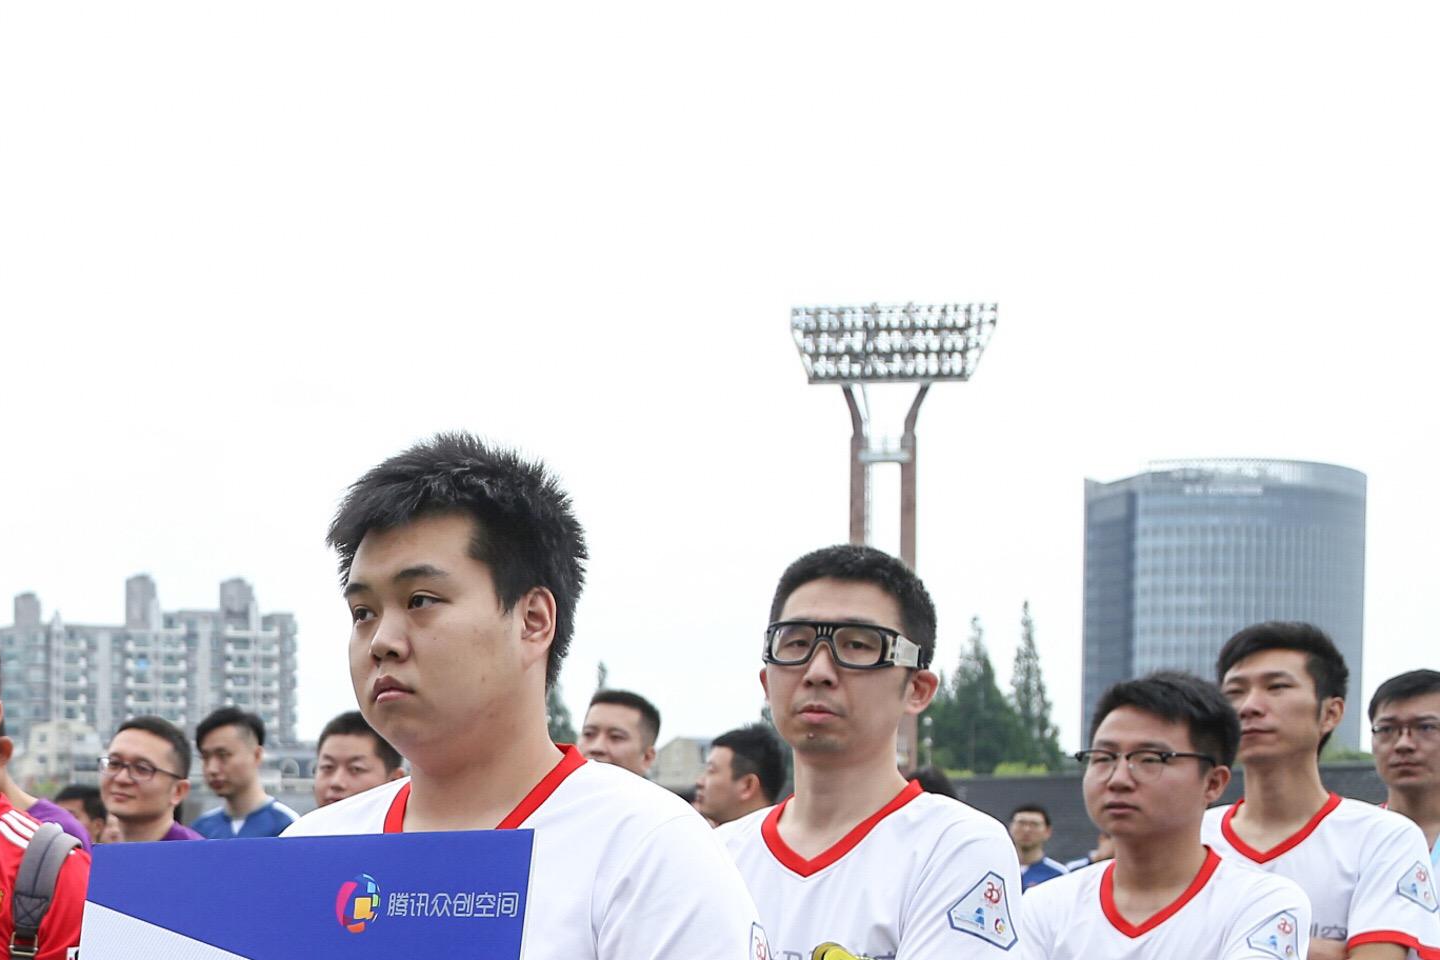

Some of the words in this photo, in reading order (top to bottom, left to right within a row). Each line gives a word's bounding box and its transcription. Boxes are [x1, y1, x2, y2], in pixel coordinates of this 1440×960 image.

[387, 891, 520, 919] 腾讯众创空间
